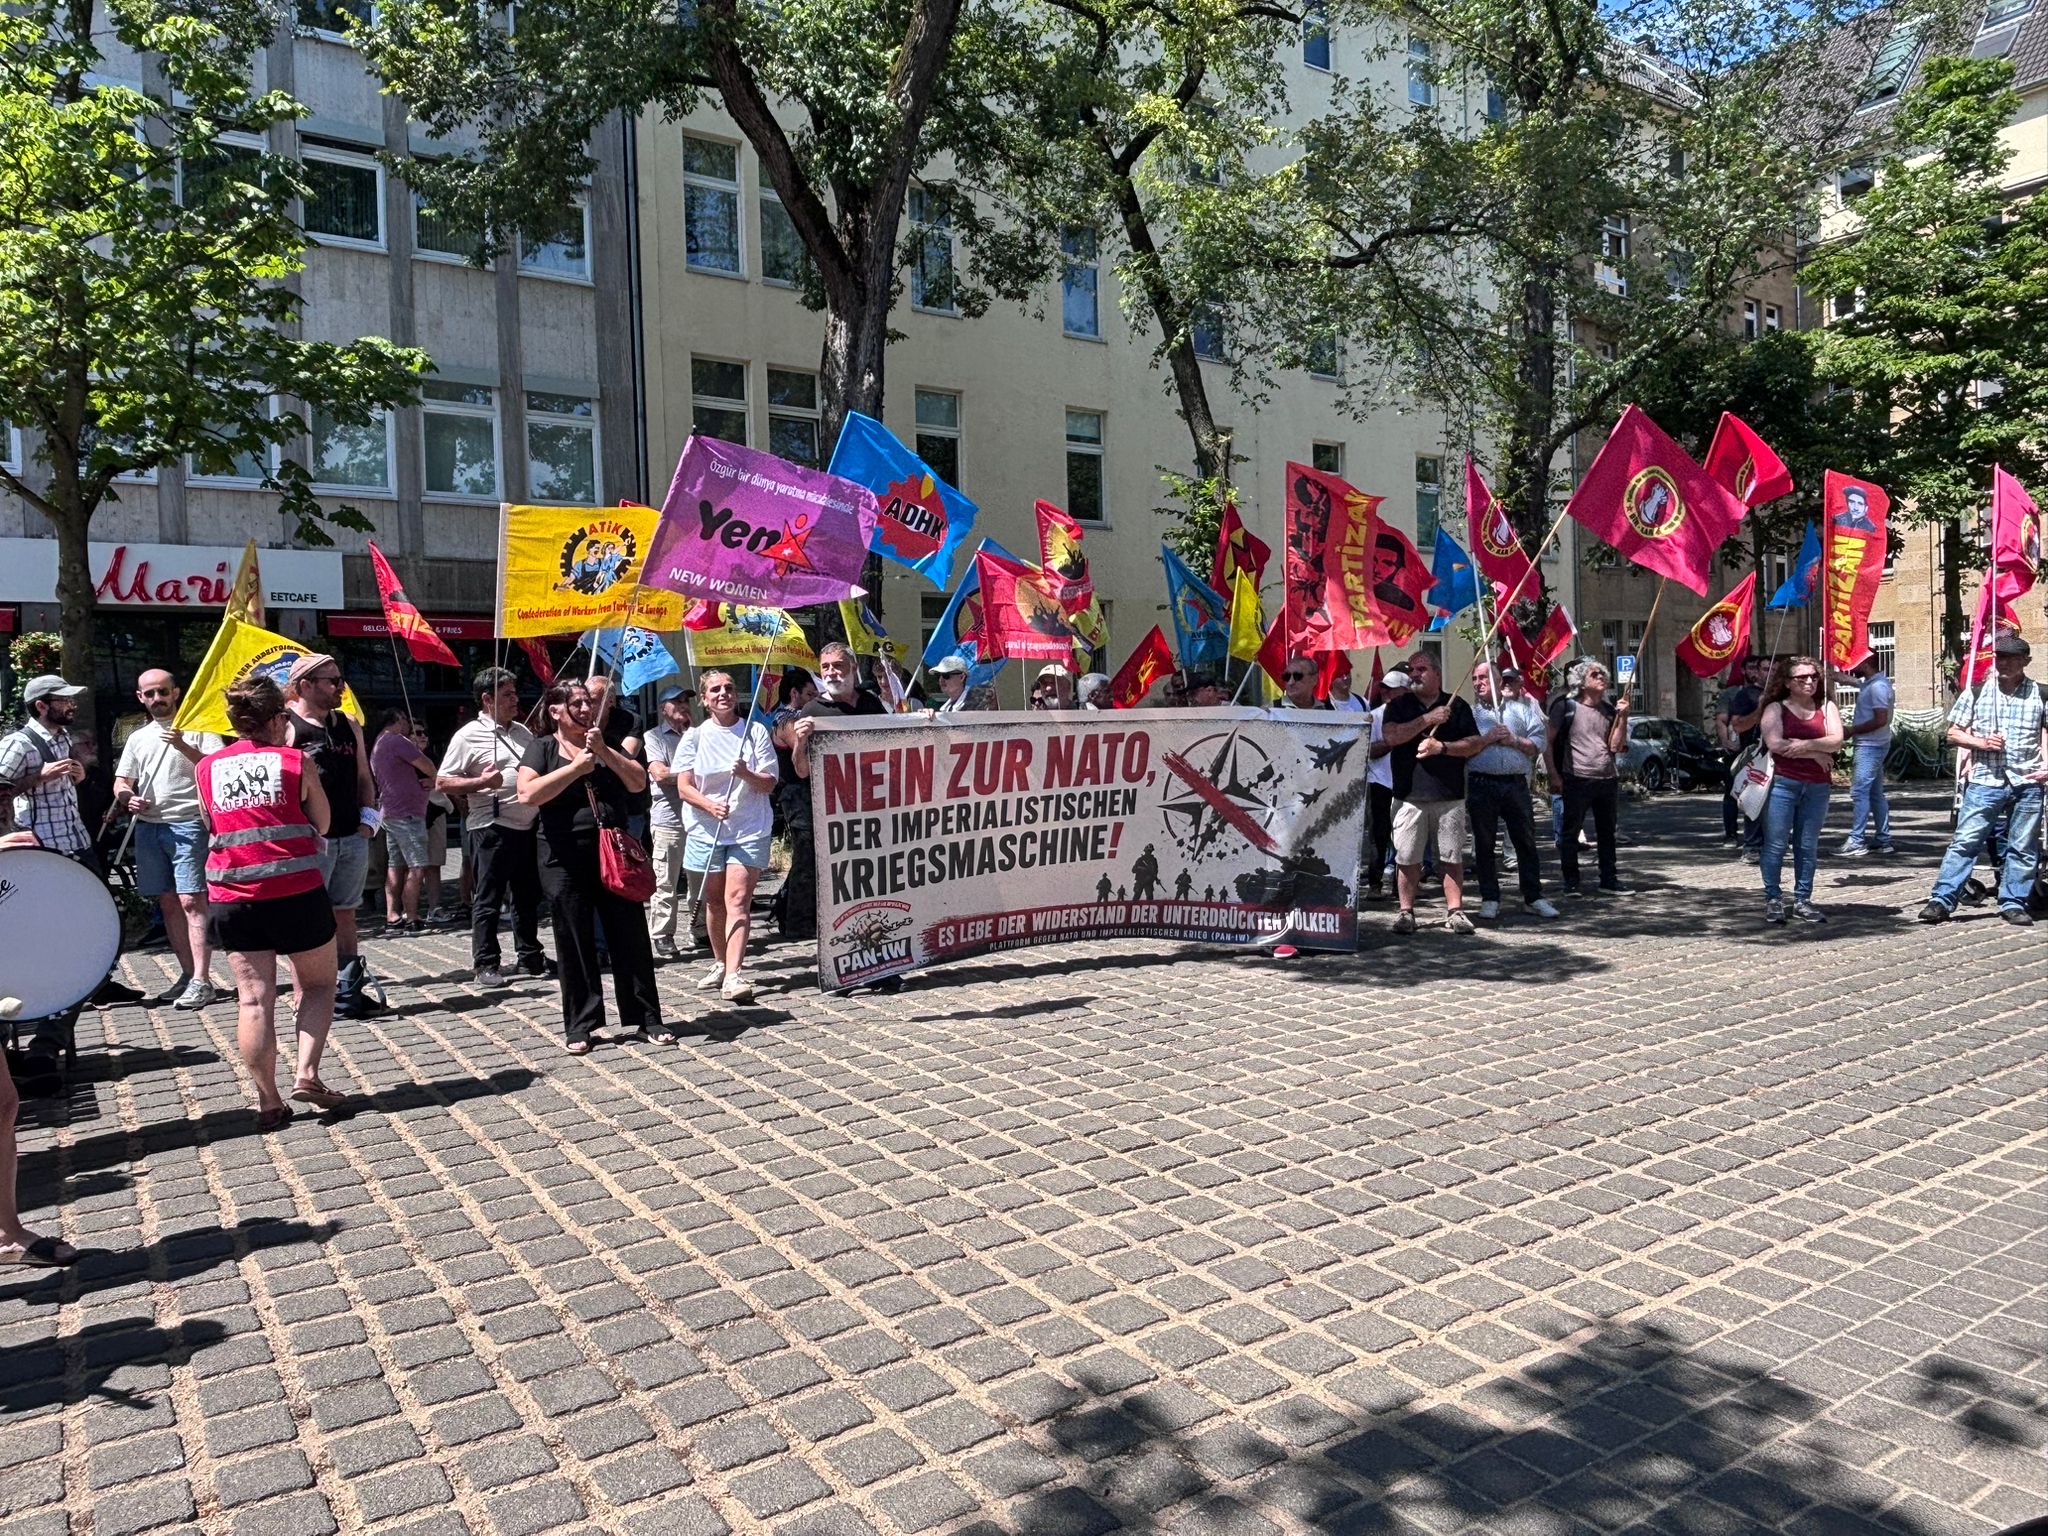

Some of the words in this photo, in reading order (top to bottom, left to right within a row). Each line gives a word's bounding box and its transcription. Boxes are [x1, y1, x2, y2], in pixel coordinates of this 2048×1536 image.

[709, 458, 736, 479] Özgür
[738, 469, 751, 482] bir
[751, 473, 776, 493] dünya
[883, 496, 945, 543] ADHK
[95, 546, 233, 603] Mari
[669, 567, 707, 587] NEW
[709, 577, 768, 600] WOMEN
[270, 591, 318, 603] EETCAFE
[518, 606, 561, 620] Confederation
[563, 606, 571, 616] of
[572, 605, 597, 616] Workers
[1621, 658, 1632, 671] P
[823, 745, 935, 816] NEIN
[947, 738, 1033, 800] ZUR
[1043, 731, 1156, 790] NATO,
[211, 791, 287, 814] AUFRUHR
[828, 817, 882, 855] DER
[892, 788, 1137, 845] IMPERIALISTISCHEN
[831, 822, 1124, 905] KRIEGSMASCHINE!
[938, 925, 955, 948] ES
[960, 918, 994, 943] LEBE
[997, 914, 1026, 936] DER
[1032, 905, 1126, 931] WIDERSTAND
[1131, 905, 1158, 923] DER
[1163, 904, 1282, 931] UNTERDRÜCKTEN
[1285, 907, 1340, 933] VÖLKER!
[989, 939, 1031, 951] PLATTFORM
[1033, 934, 1057, 944] GEGEN
[1060, 931, 1078, 940] NATO
[1081, 929, 1096, 938] UND
[1100, 928, 1180, 937] IMPERIALISTISCHEN
[1183, 929, 1208, 940] KRIEG
[1211, 930, 1250, 942] (PAN-IW)
[838, 939, 907, 975] PAN-IW
